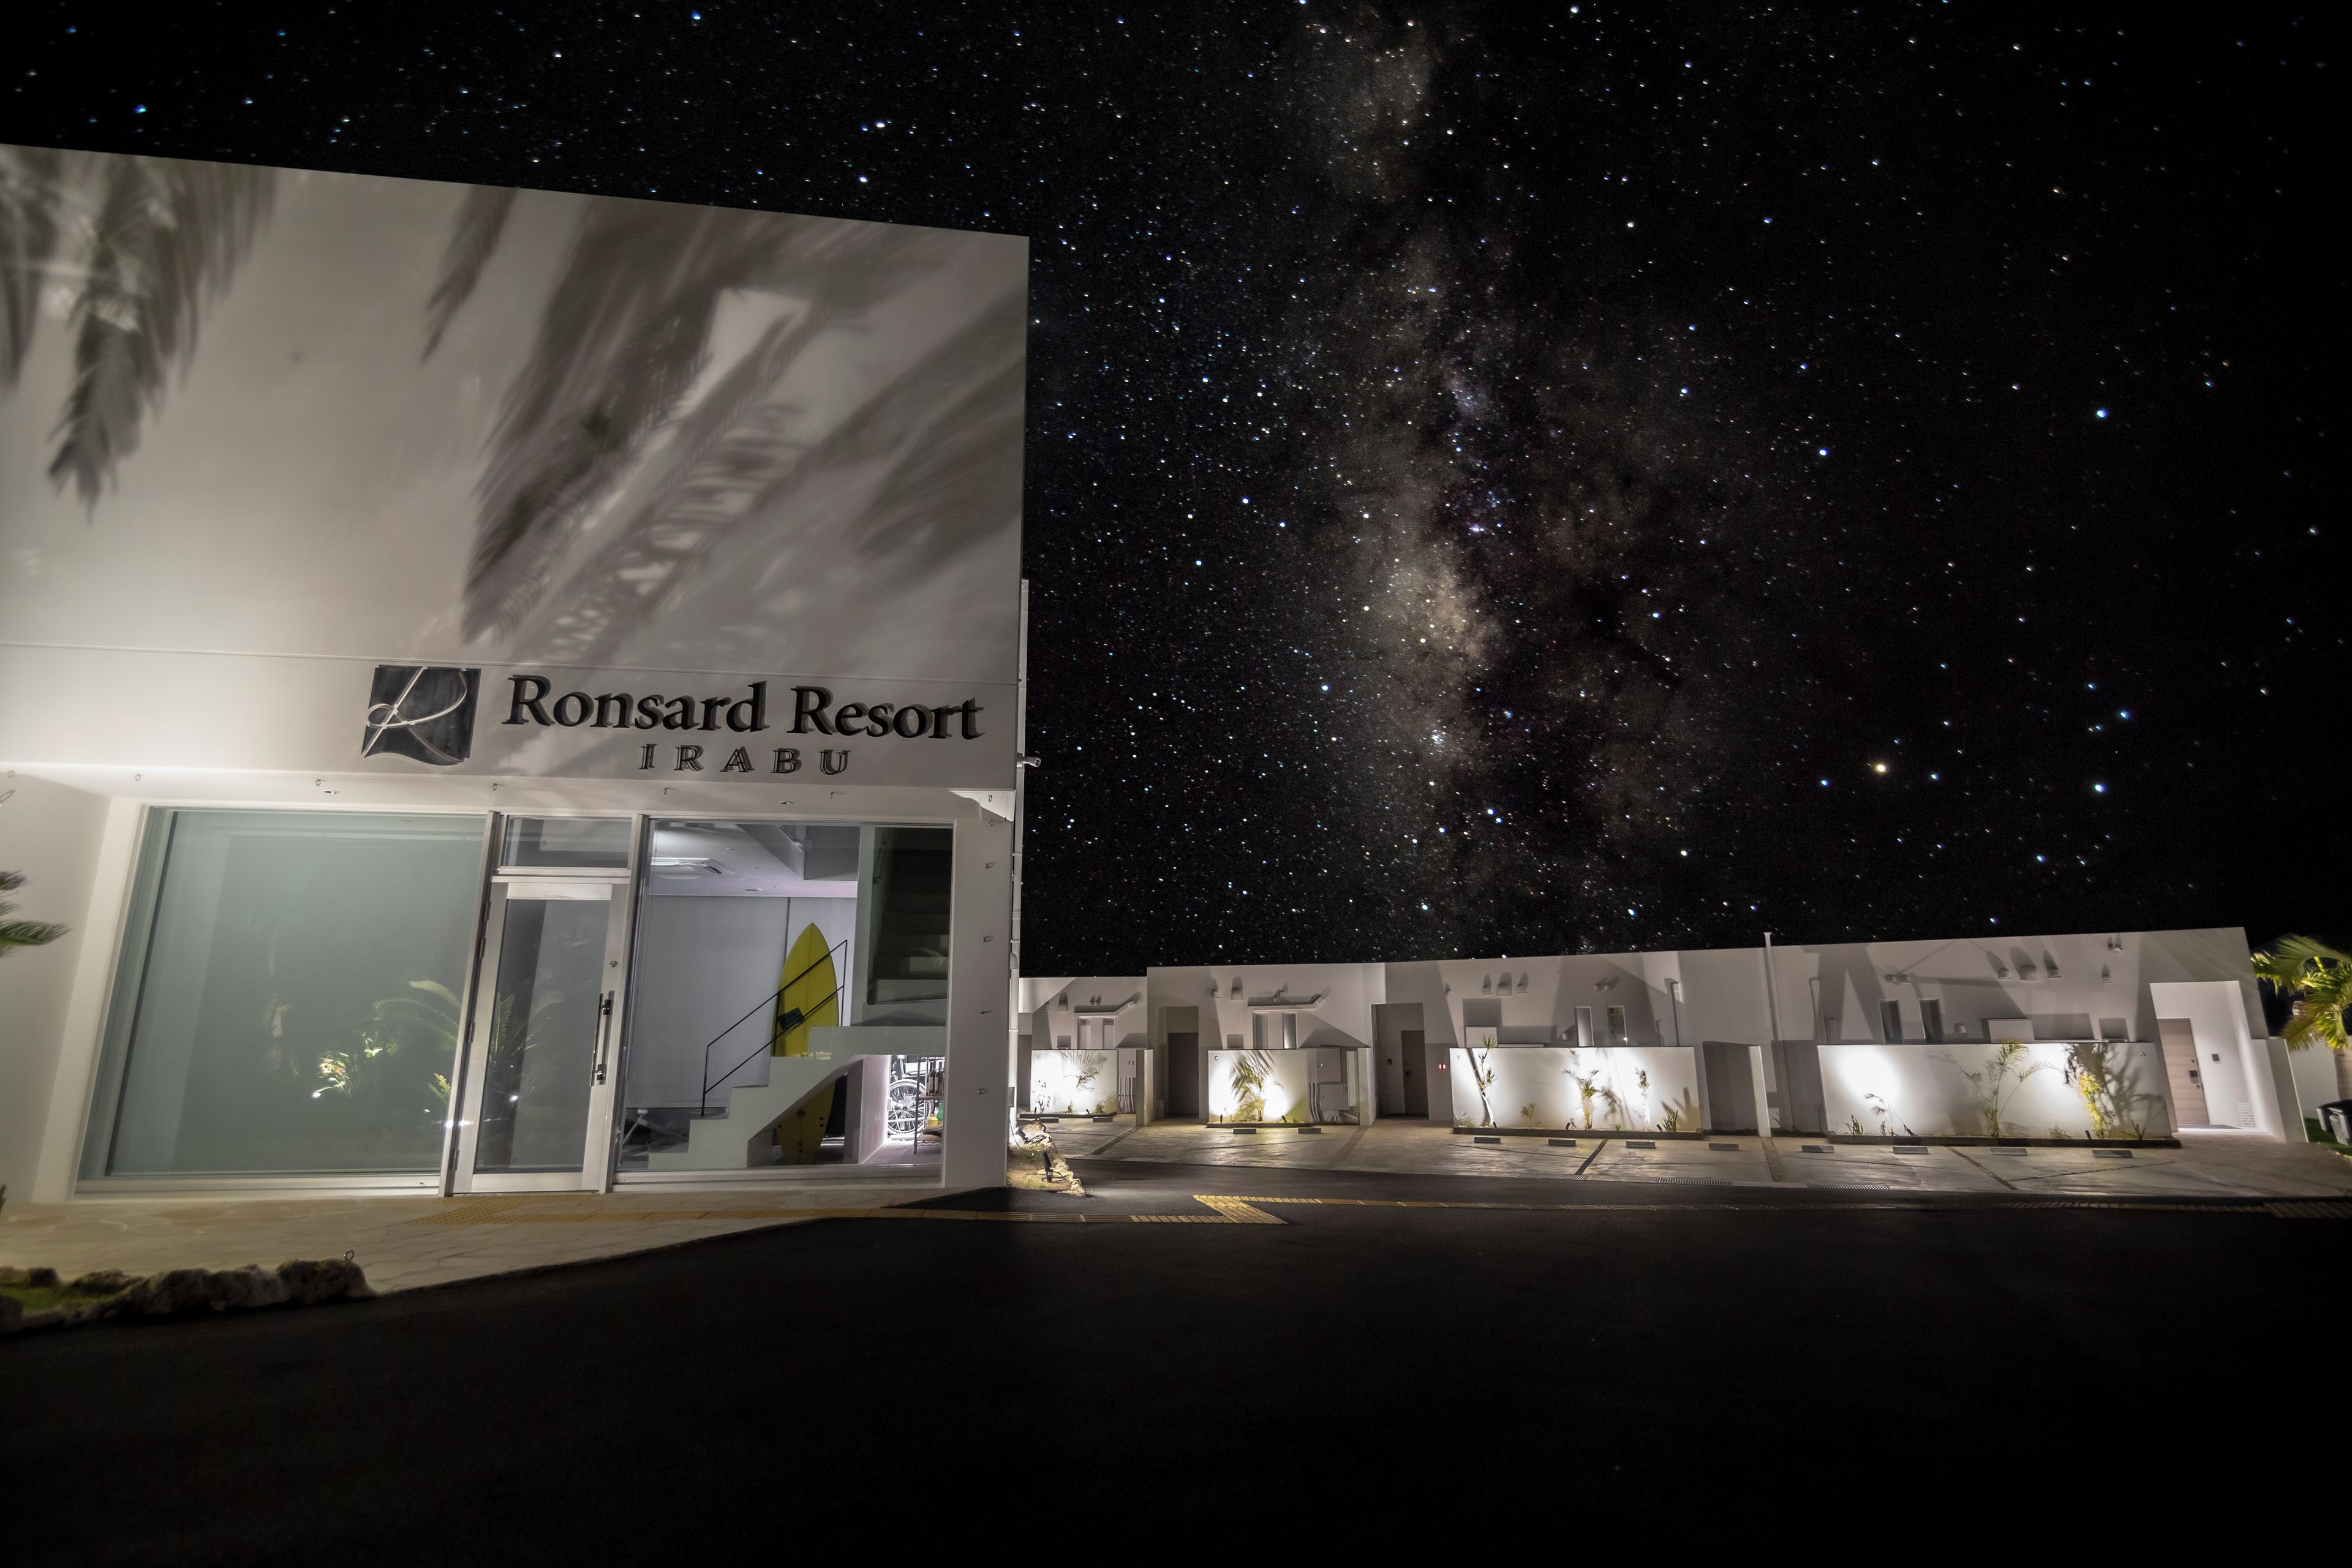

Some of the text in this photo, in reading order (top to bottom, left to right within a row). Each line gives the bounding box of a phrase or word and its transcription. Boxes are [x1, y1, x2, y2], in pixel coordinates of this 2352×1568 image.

[502, 674, 985, 740] Ronsard Resort
[638, 744, 851, 775] IRABU
